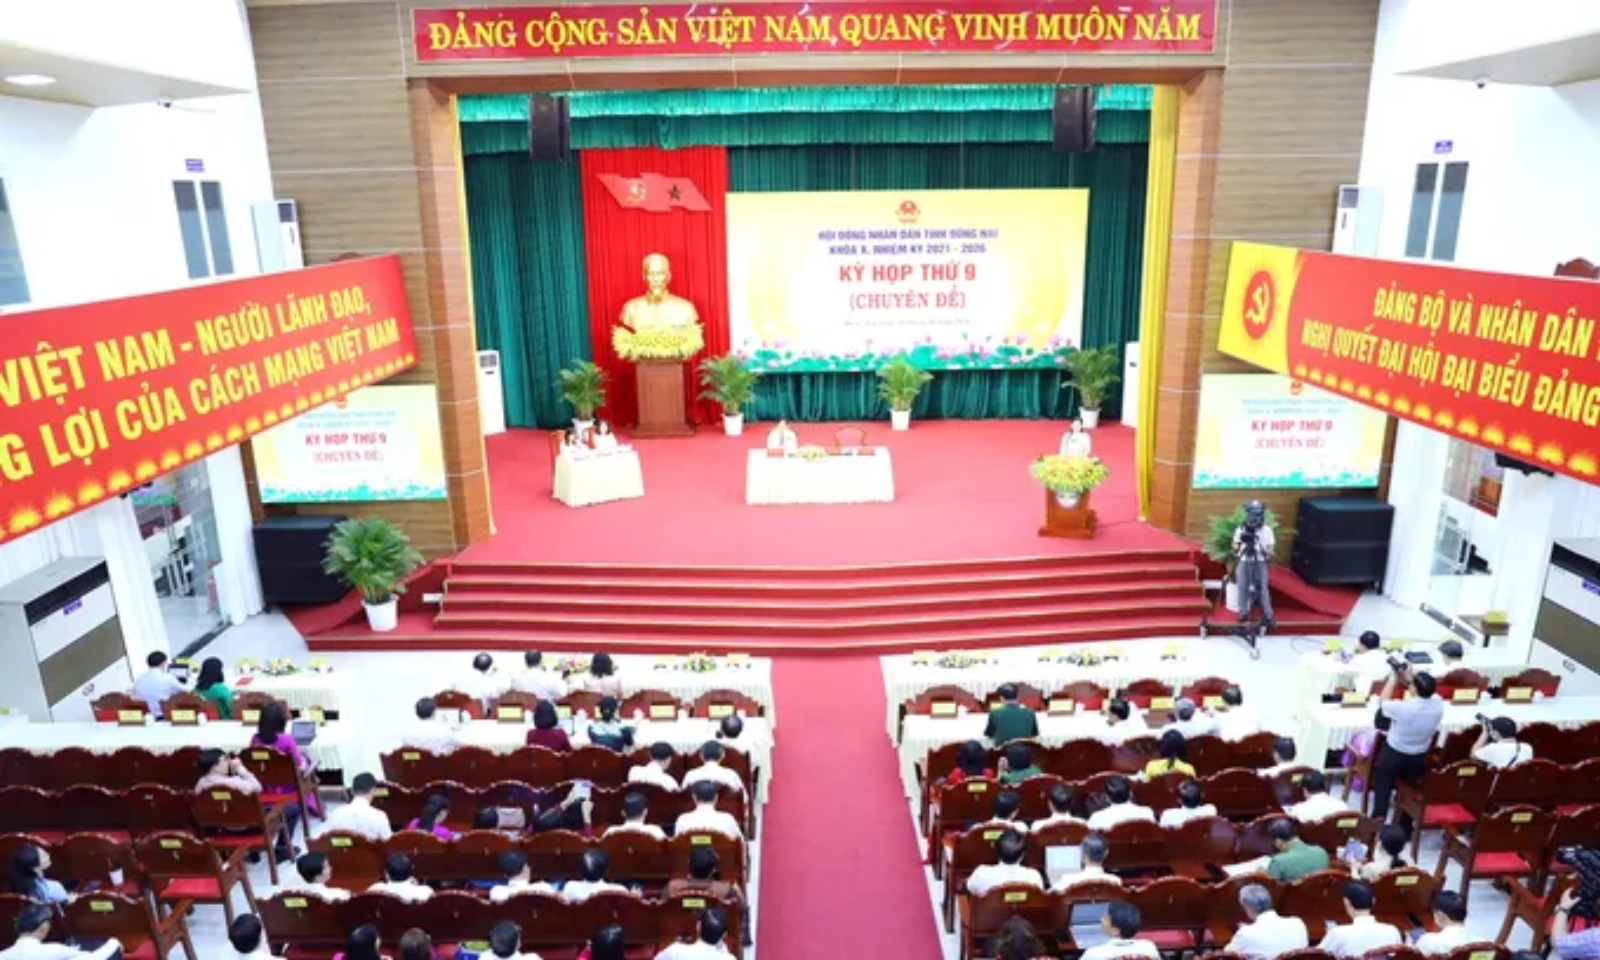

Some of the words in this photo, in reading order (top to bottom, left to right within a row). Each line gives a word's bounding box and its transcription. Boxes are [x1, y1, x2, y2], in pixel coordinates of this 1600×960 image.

[428, 11, 517, 50] ĐẢNG
[525, 11, 610, 52] CỘNG
[617, 8, 679, 45] SẢN
[685, 8, 756, 50] VIỆT
[840, 13, 947, 46] QUANG
[952, 13, 1028, 41] VINH
[1132, 6, 1201, 41] NĂM
[839, 261, 865, 282] KỲ
[872, 264, 913, 285] HỌP
[921, 260, 959, 281] THỨ
[964, 263, 976, 281] 9
[850, 289, 929, 310] (CHUYÊN
[95, 328, 176, 382] NAM
[195, 301, 274, 356] NGƯỜI
[276, 293, 328, 334] LÃNH
[329, 285, 371, 322] ĐẠO,
[1373, 280, 1418, 325] ĐẢNG
[1418, 289, 1446, 337] BỘ
[1448, 292, 1474, 336] VÀ
[1475, 299, 1538, 348] NHÂN
[1538, 307, 1596, 359] DÂN
[39, 405, 109, 466] LỢI
[115, 381, 187, 440] CỦA
[189, 364, 262, 415] CÁCH
[263, 340, 325, 388] MẠNG
[325, 324, 363, 365] VIỆT
[365, 317, 400, 352] NAM
[1301, 318, 1333, 359] NGHỊ
[1332, 323, 1379, 364] QUYẾT
[1377, 338, 1408, 379] ĐẠI
[1407, 341, 1441, 388] HỘI
[1441, 354, 1477, 399] ĐẠI
[1477, 352, 1531, 408] BIỂU
[1532, 368, 1600, 427] ĐẢNG
